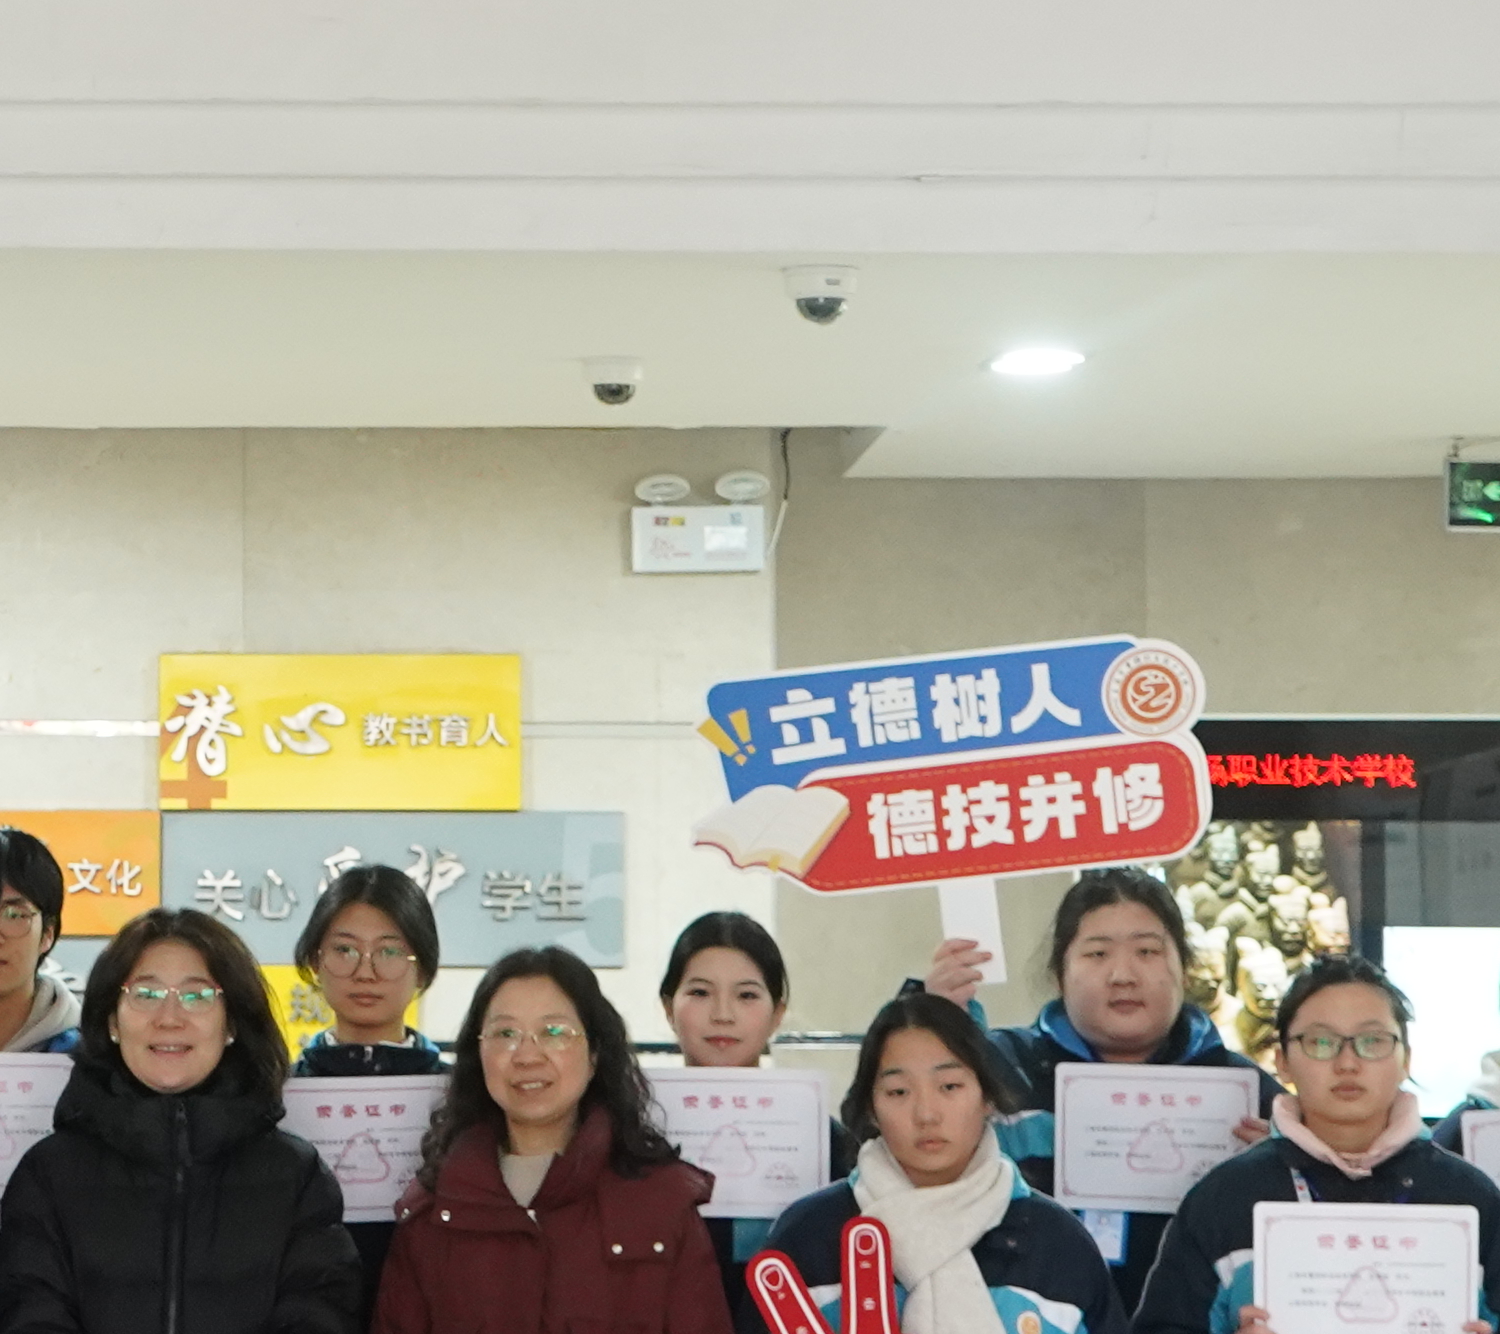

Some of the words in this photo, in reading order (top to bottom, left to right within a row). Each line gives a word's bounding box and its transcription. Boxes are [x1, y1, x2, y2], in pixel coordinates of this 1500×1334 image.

[165, 685, 346, 776] 潜心
[361, 712, 509, 748] 教书育人
[768, 663, 1081, 766] 立德树人
[865, 760, 1166, 862] 德技并修
